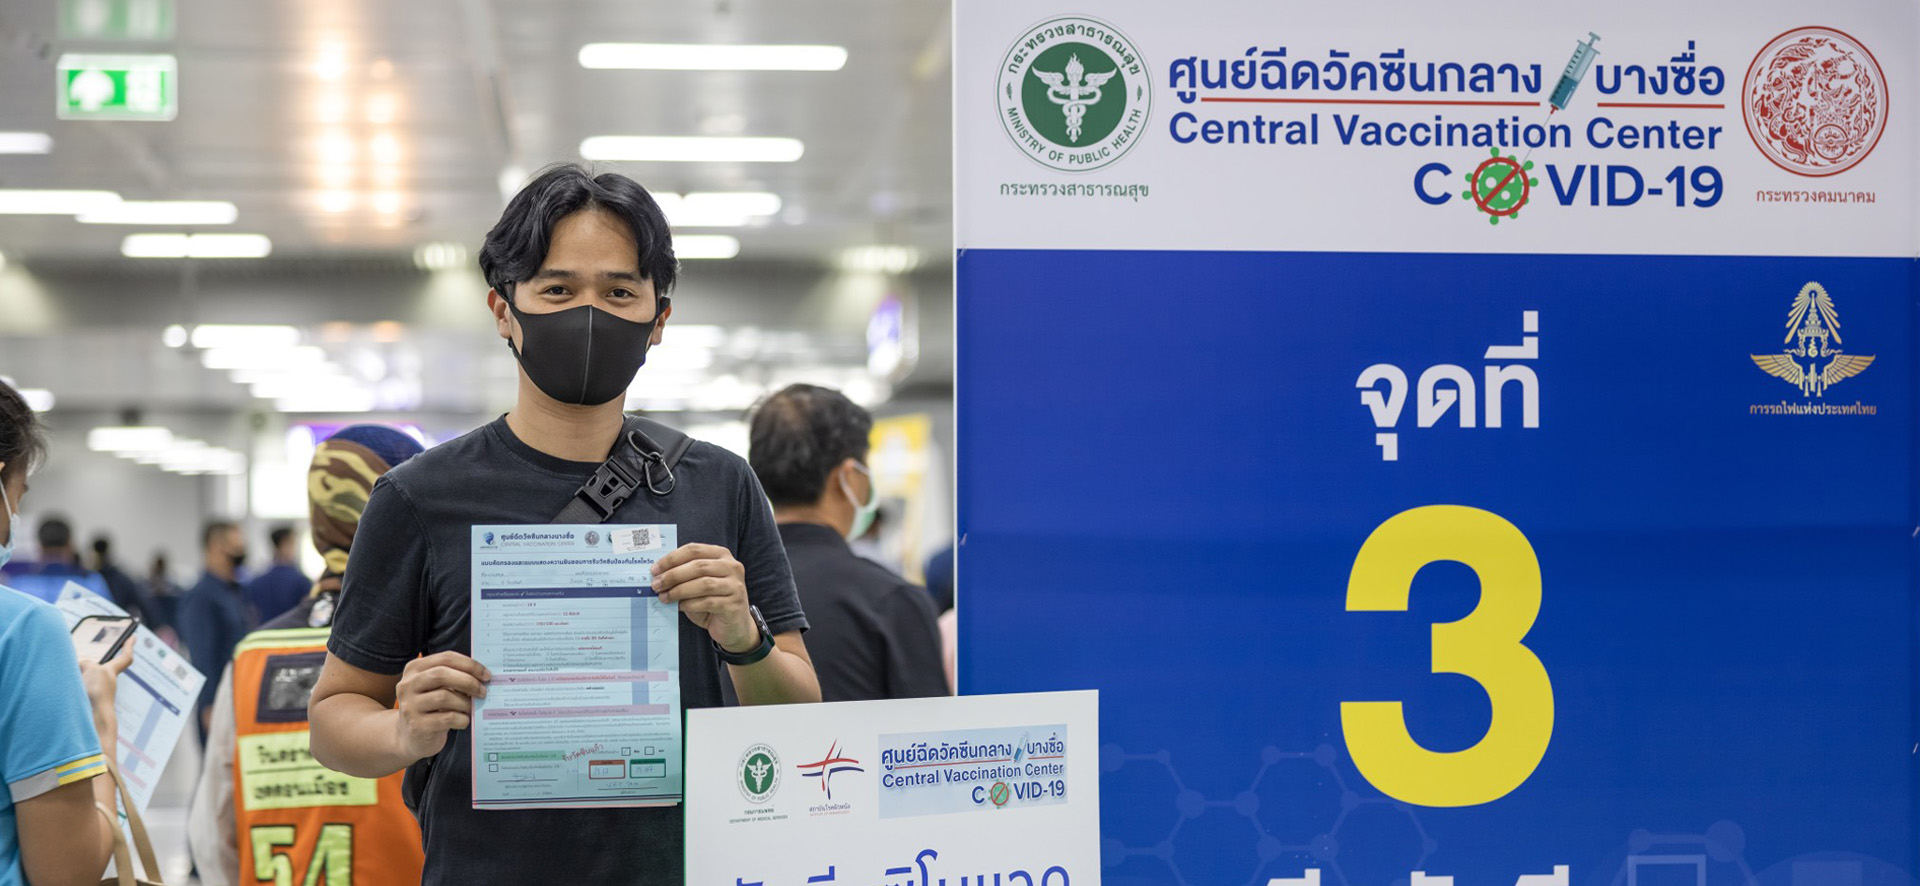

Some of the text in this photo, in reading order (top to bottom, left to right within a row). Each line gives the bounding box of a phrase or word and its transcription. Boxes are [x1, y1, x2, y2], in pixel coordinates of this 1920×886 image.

[1008, 23, 1141, 75] กระทรวงสาธารณสุข
[1169, 40, 1725, 104] ศูนย์ฉีดวัคซีนกลาง บางซื่อ
[1007, 107, 1142, 165] MINISTRY OF PUBLIC HEALTH
[1169, 112, 1723, 150] Central Vaccination Center
[1000, 182, 1149, 202] กระทรวงสาธารณสุข
[1756, 189, 1876, 204] กระทรวงคมนาคม
[1355, 310, 1540, 461] จุดที่
[1750, 400, 1877, 415] การรถไฟแห่งประเทศไทย
[1340, 504, 1555, 808] 3
[881, 731, 1064, 771] ศูนย์ฉีดวัคซีนกลาง บางซื่อ
[882, 762, 1064, 788] Central Vaccination Center
